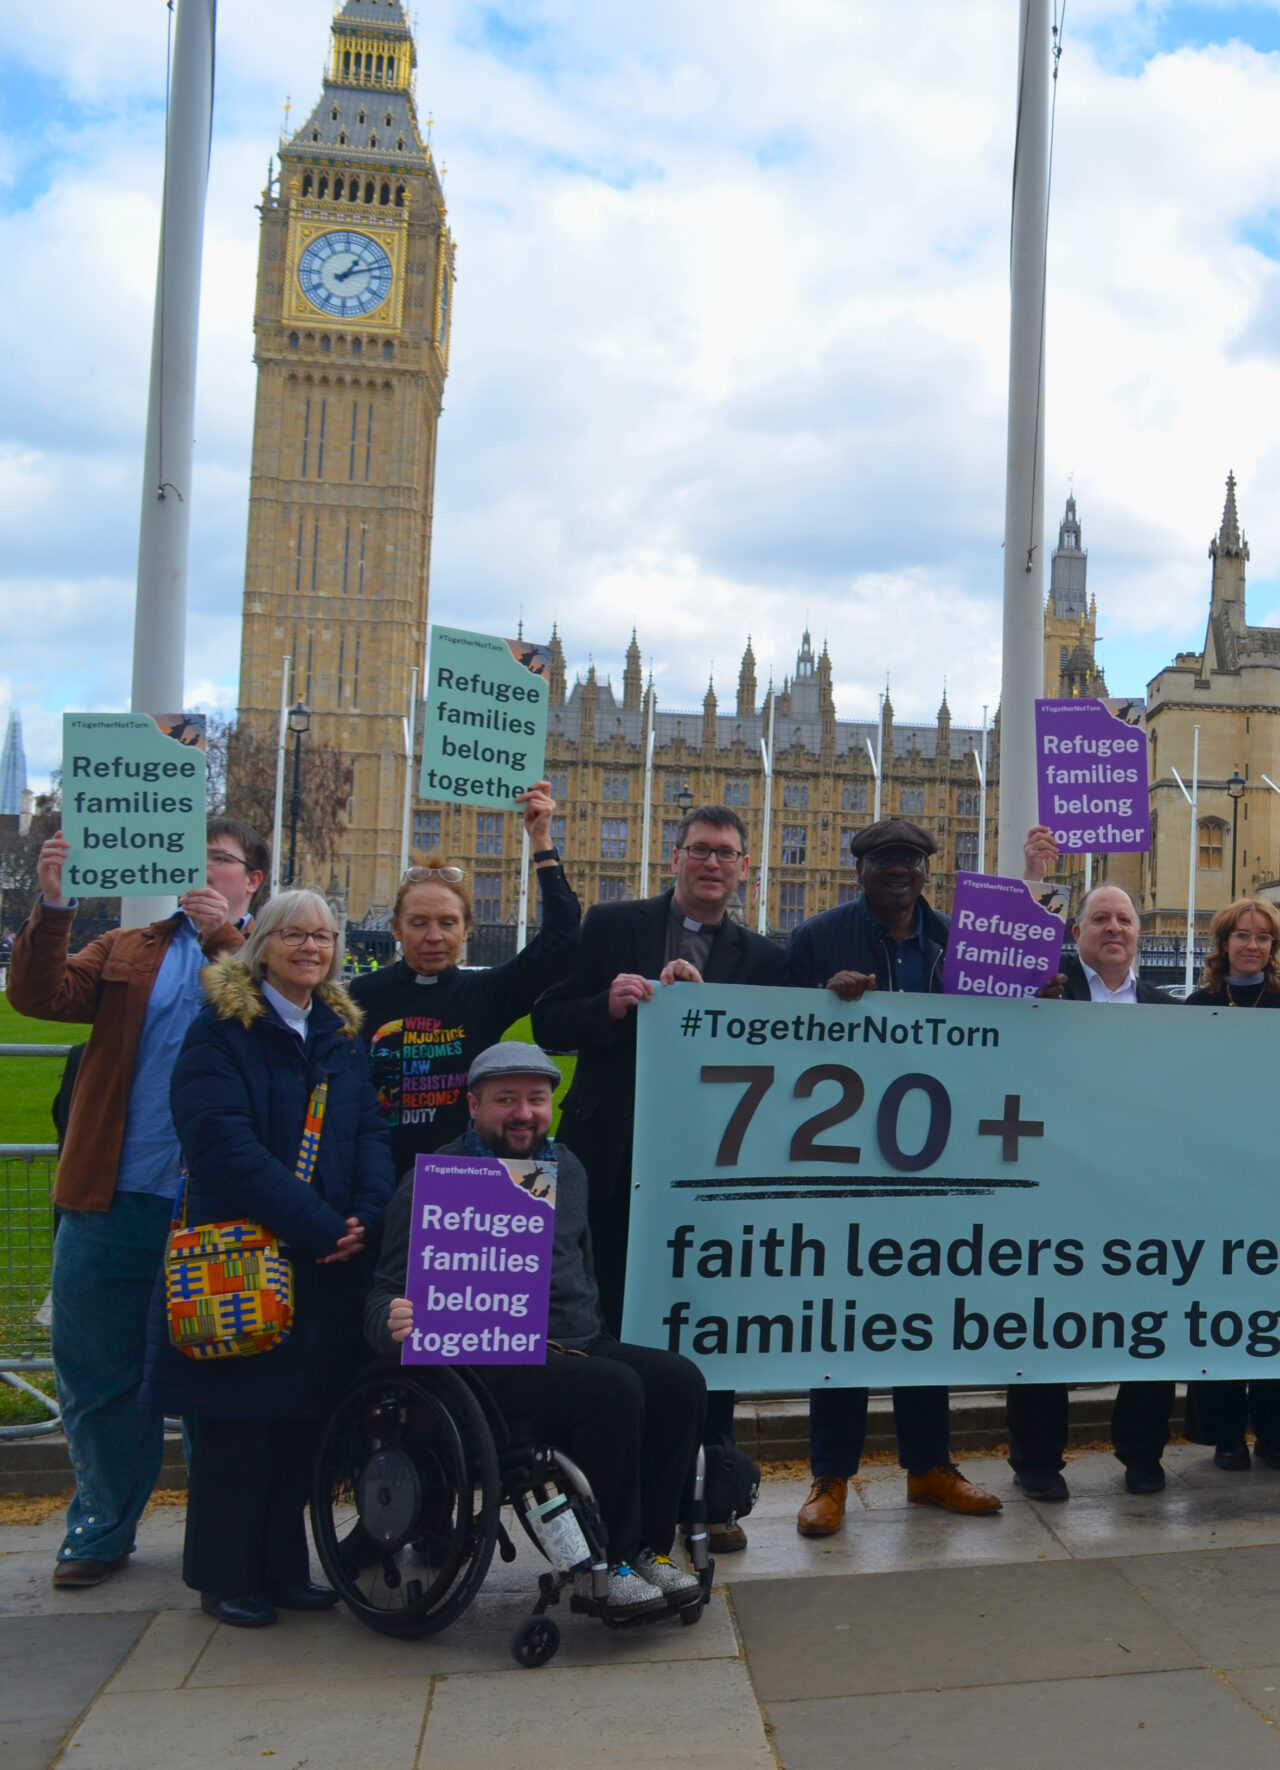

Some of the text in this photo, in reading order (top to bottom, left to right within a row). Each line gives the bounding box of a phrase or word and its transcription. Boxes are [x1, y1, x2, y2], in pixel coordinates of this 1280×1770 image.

[438, 668, 539, 703] Refugee
[438, 702, 535, 735] families
[442, 735, 527, 771] belong
[1044, 735, 1138, 757] Refugee
[73, 756, 195, 781] Refugee
[1046, 764, 1138, 784] families
[428, 770, 532, 799] togethe
[74, 791, 193, 813] families
[1054, 795, 1133, 816] belong
[83, 827, 184, 852] belong
[69, 863, 199, 888] together
[959, 910, 1056, 941] Refugee
[956, 941, 1049, 971] families
[403, 1025, 466, 1044] INJUSTICE
[404, 1017, 442, 1032] WHEN
[681, 1010, 1000, 1047] #TogetherNotTorn
[403, 1042, 463, 1058] BECOMES
[403, 1061, 430, 1075] LAW
[402, 1089, 460, 1108] BECOMES
[402, 1108, 436, 1124] DUTY
[701, 1064, 1044, 1172] 720+
[421, 1205, 545, 1237] Refugee
[421, 1245, 540, 1273] families
[667, 1223, 826, 1278] faith
[847, 1223, 1084, 1277] leaders
[1101, 1238, 1205, 1286] say
[428, 1289, 529, 1317] belong
[662, 1298, 933, 1354] families
[953, 1297, 1168, 1360] belong
[411, 1329, 541, 1356] together
